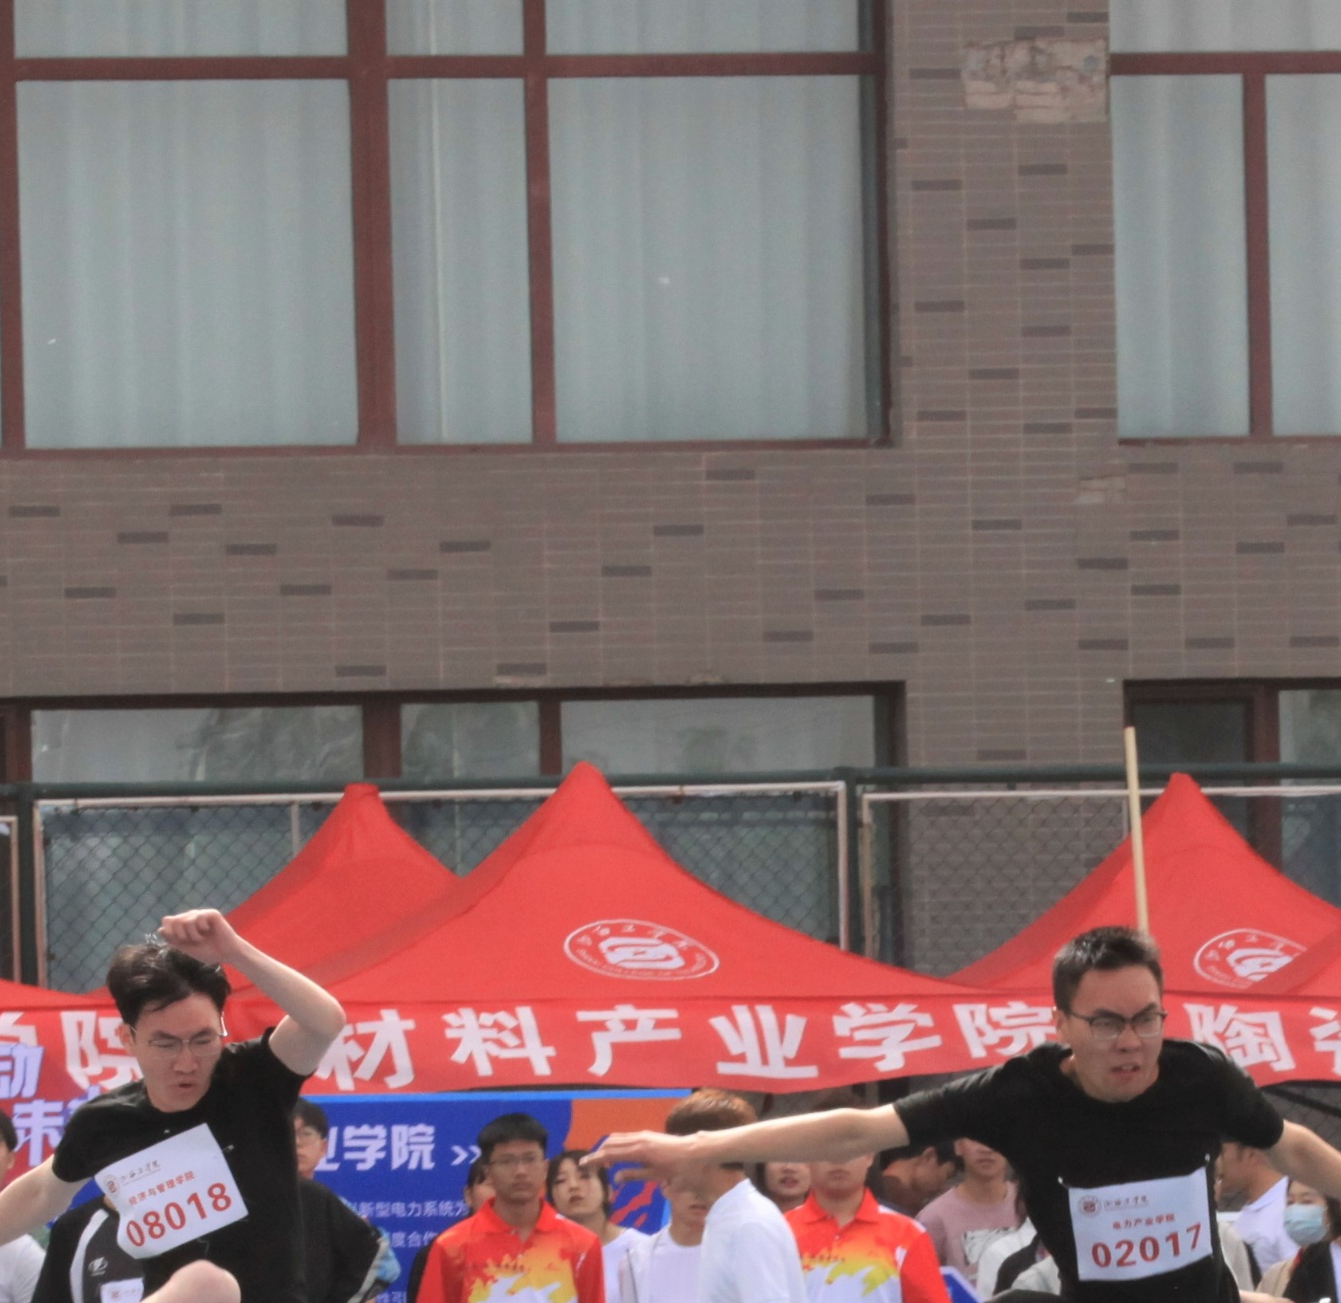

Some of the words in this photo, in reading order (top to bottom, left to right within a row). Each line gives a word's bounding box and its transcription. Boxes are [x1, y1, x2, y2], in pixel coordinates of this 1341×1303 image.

[313, 1002, 1054, 1090] 材料产业学院
[126, 1182, 232, 1247] 08018
[1091, 1221, 1202, 1268] 02017
